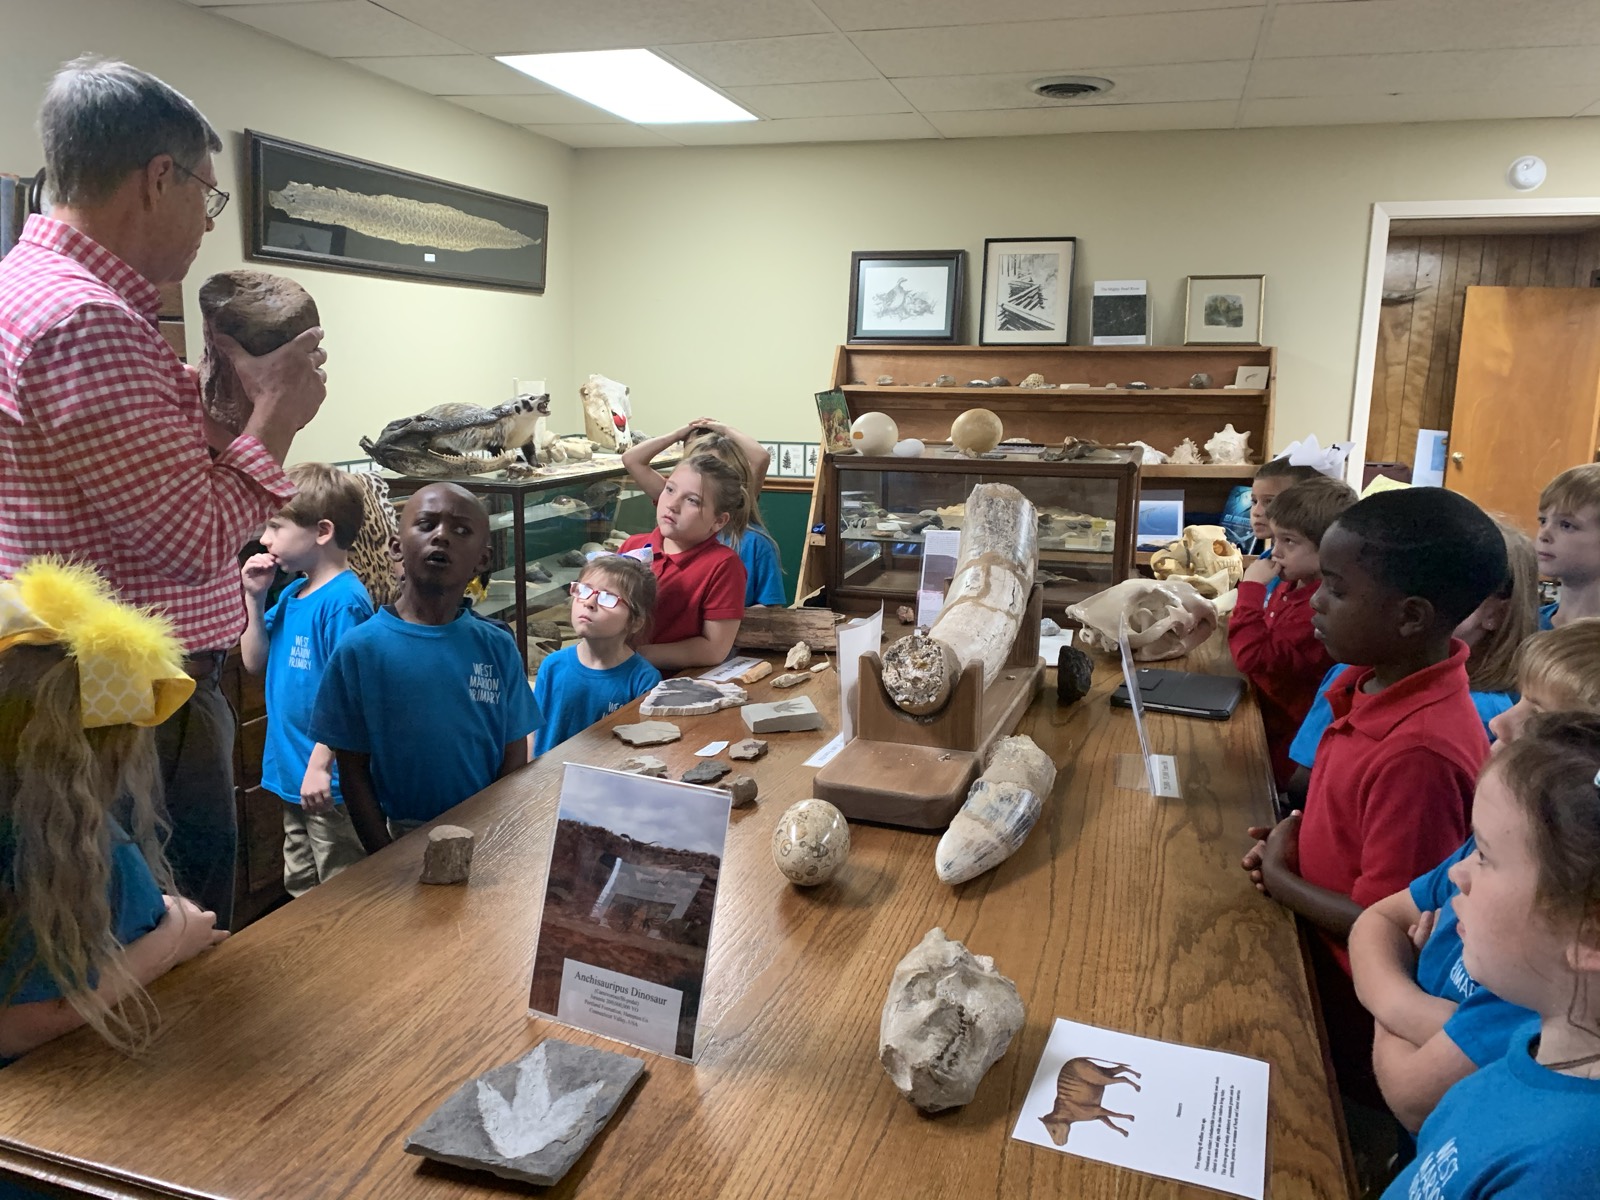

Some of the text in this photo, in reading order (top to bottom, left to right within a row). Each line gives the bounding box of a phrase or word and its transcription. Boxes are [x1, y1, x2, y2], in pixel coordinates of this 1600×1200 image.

[472, 662, 494, 677] WEST
[469, 675, 499, 692] MARION
[468, 688, 501, 705] PRIMARY
[574, 971, 667, 1006] Anchisauripus Dinosaur
[1436, 1136, 1459, 1188] WEST
